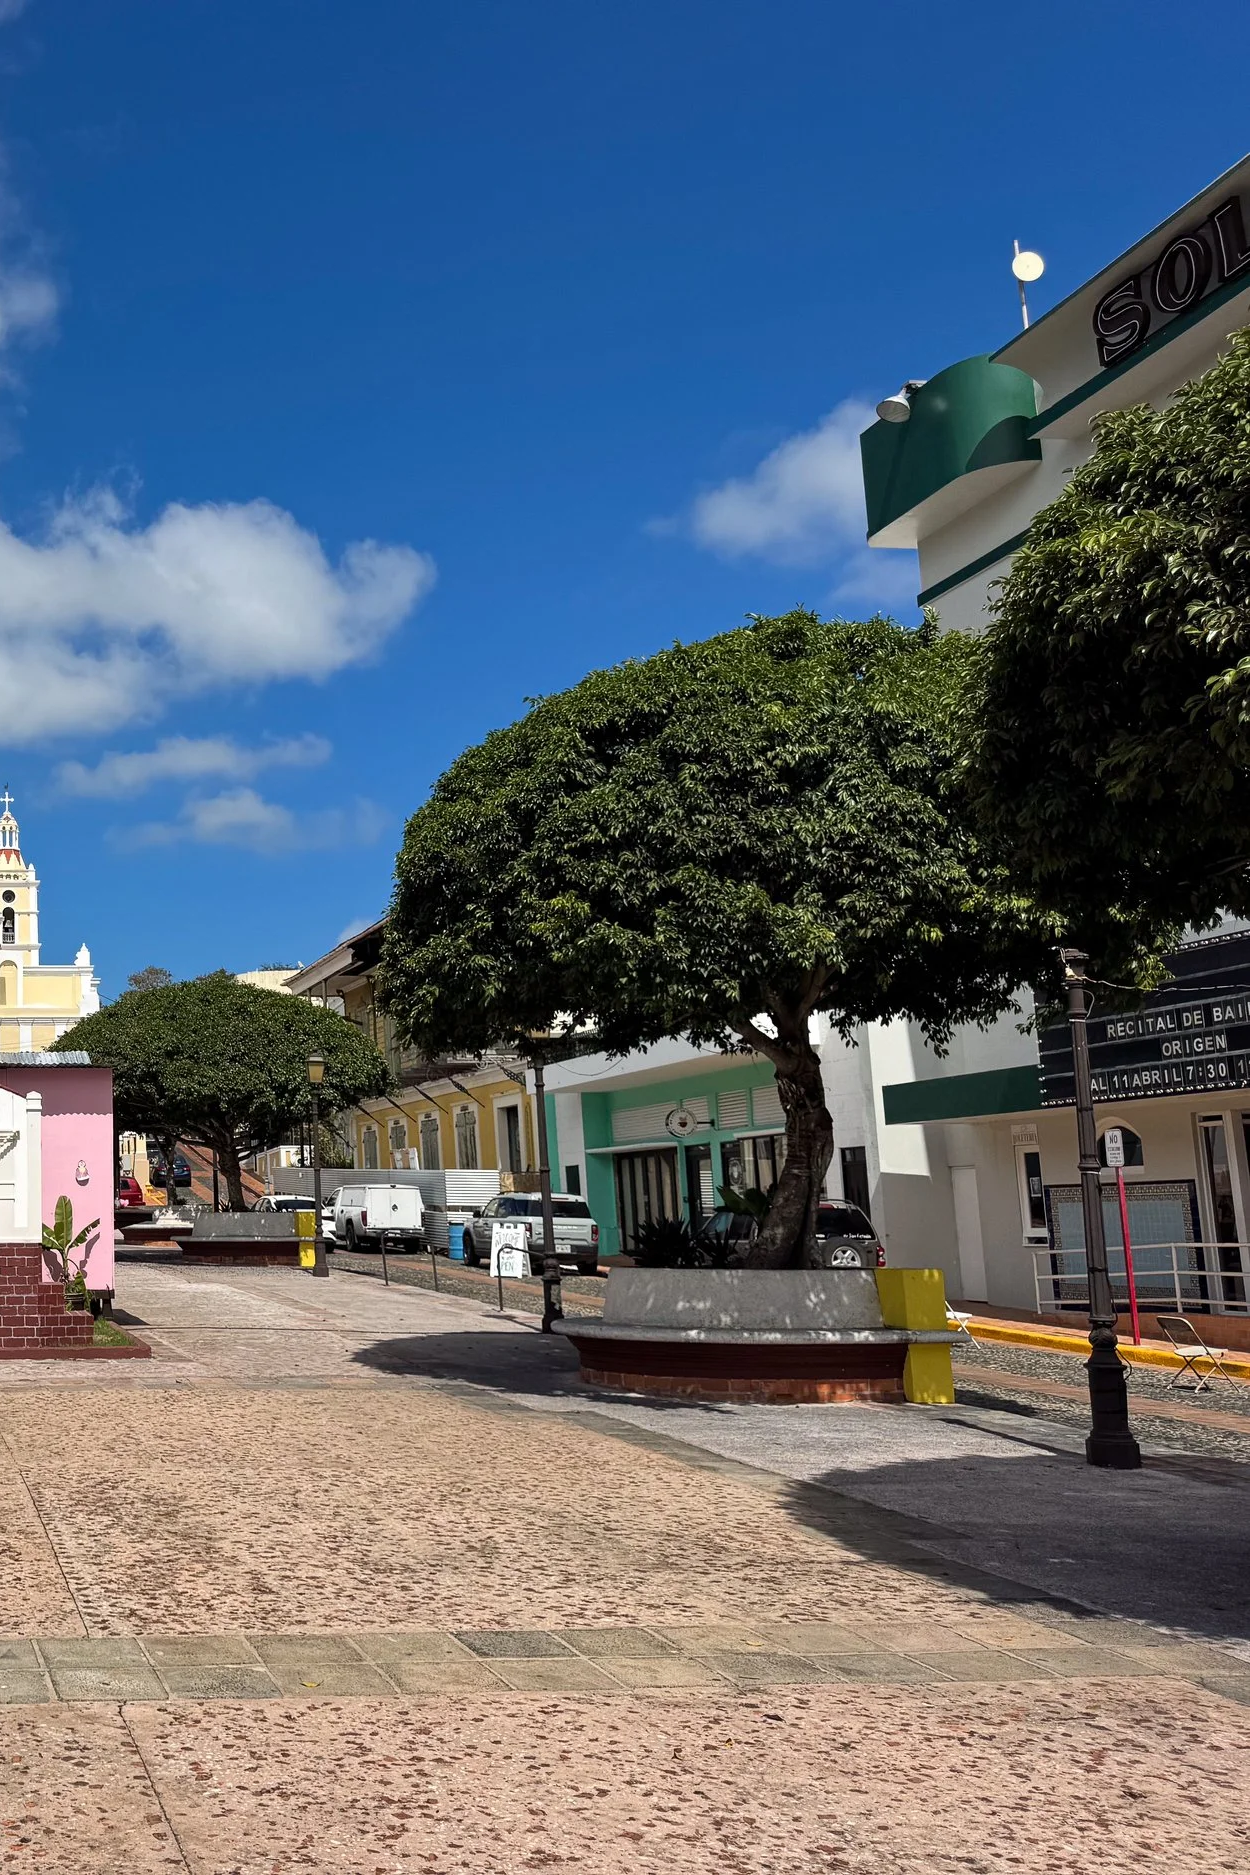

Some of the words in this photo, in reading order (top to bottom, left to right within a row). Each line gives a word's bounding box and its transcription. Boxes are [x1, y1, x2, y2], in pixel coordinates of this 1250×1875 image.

[1092, 195, 1250, 367] SOL
[1107, 1014, 1175, 1038] RECITAL
[1183, 1011, 1203, 1027] DE
[1212, 1002, 1250, 1021] BAI
[1162, 1034, 1226, 1056] ORIGEN
[1109, 1133, 1118, 1144] NO
